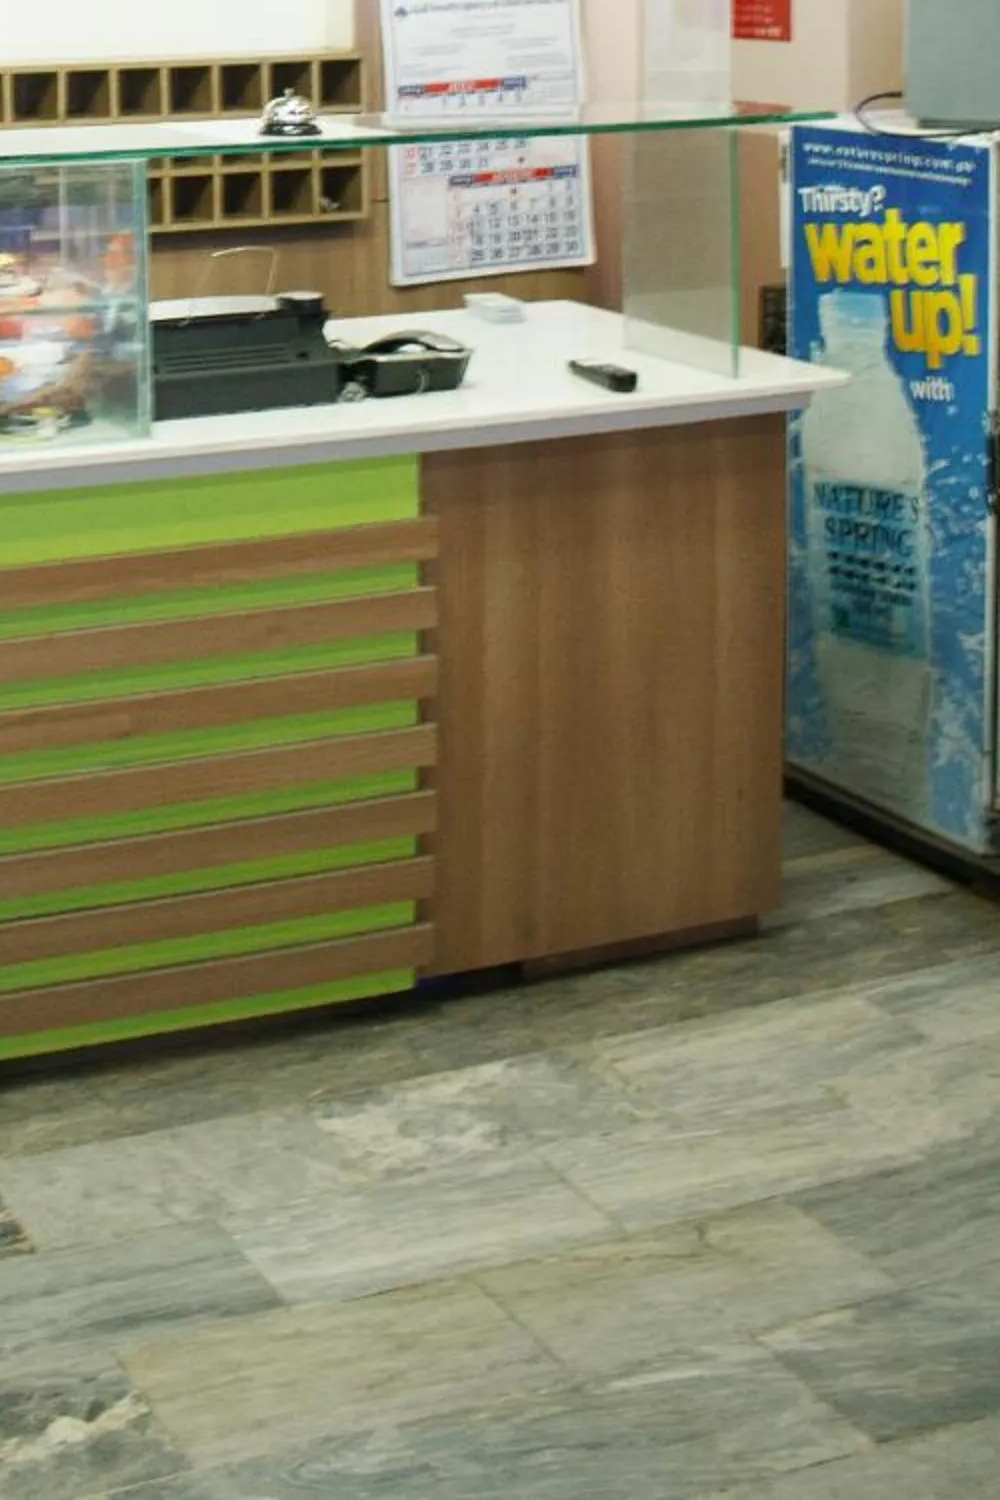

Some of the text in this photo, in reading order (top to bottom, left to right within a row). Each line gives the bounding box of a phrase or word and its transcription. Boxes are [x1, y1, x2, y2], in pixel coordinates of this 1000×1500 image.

[798, 184, 886, 217] Thirsty?
[804, 208, 966, 286] water
[890, 273, 981, 370] up!
[909, 376, 954, 402] with
[823, 515, 914, 559] SPRING
